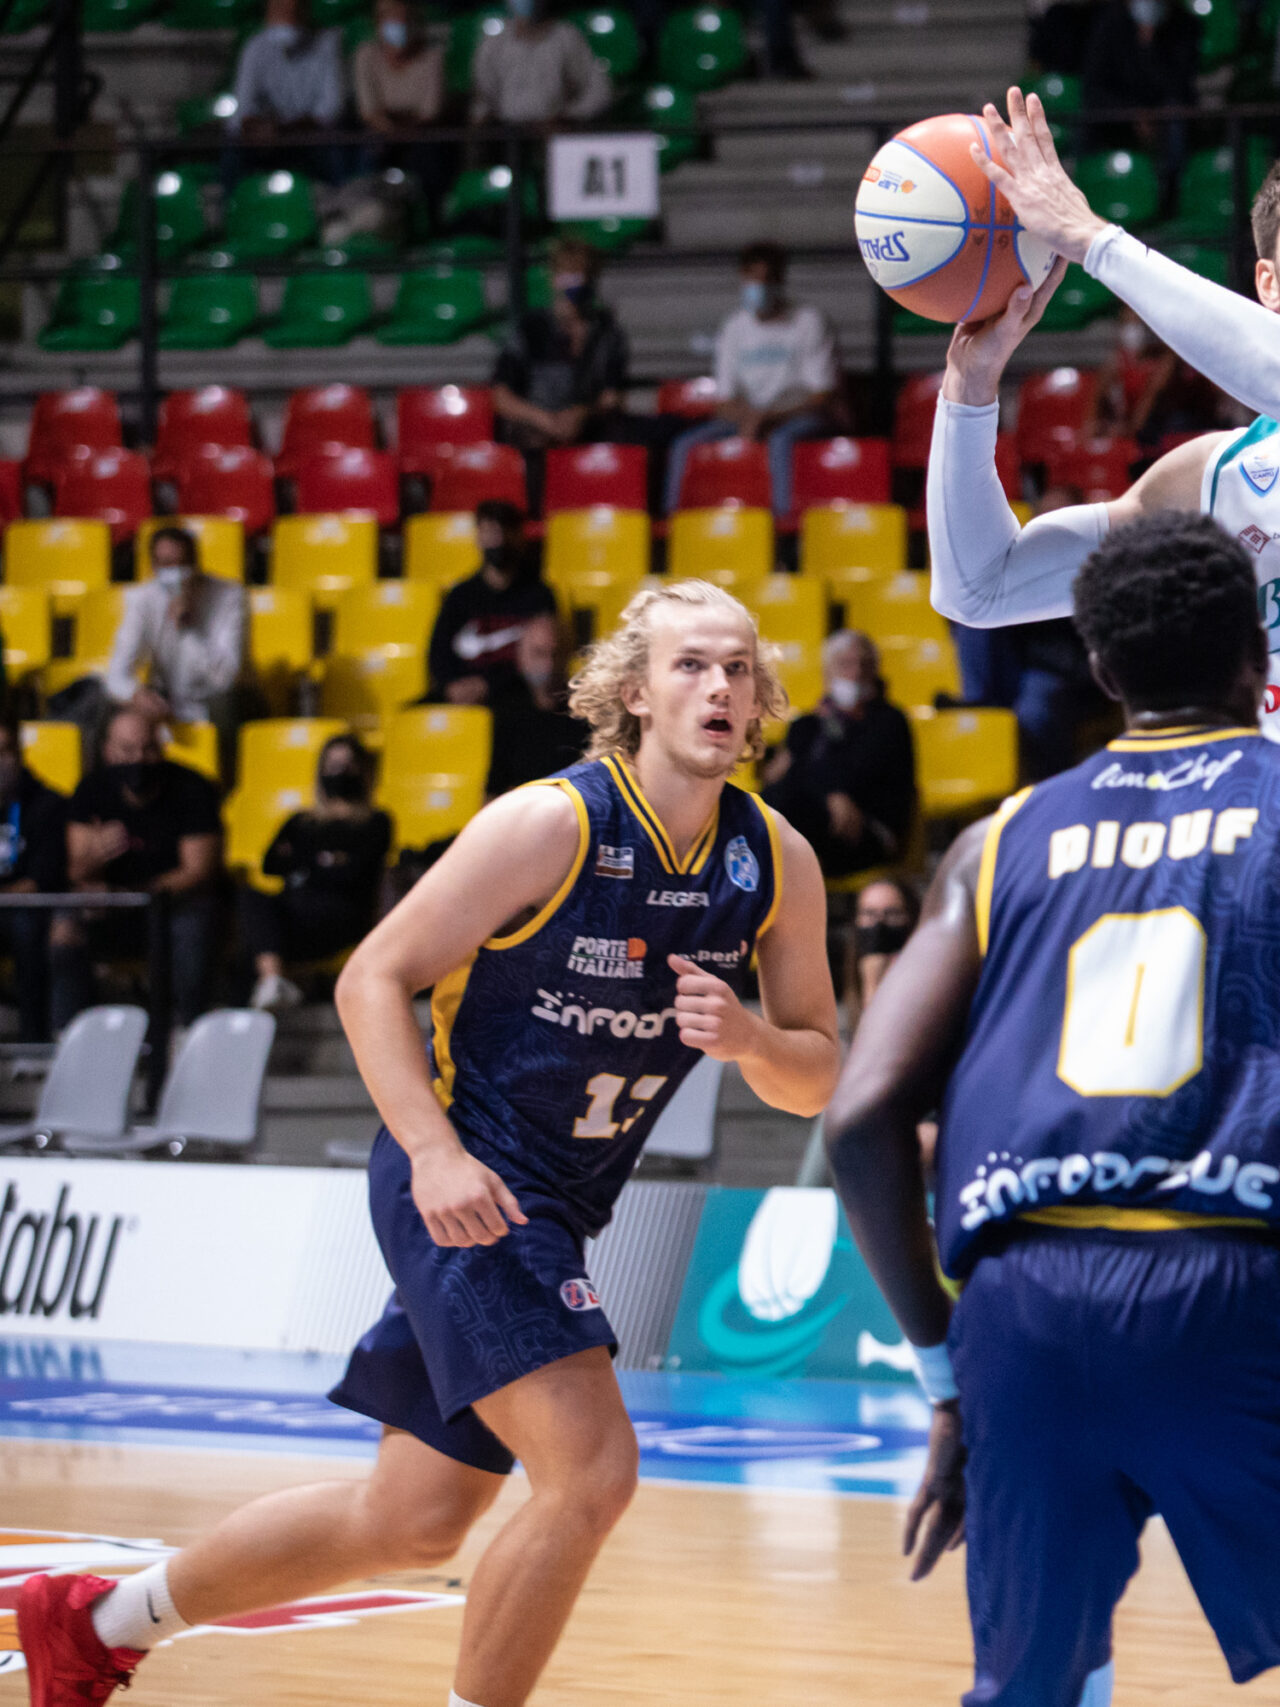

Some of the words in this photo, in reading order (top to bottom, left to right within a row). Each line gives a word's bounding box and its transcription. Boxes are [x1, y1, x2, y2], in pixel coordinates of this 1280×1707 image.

[584, 157, 626, 196] A1
[1047, 807, 1259, 880] DIOUF
[646, 890, 711, 907] LEGEA
[572, 935, 628, 956] PORTE
[566, 954, 644, 978] ITALIANE
[1055, 905, 1208, 1099] 0
